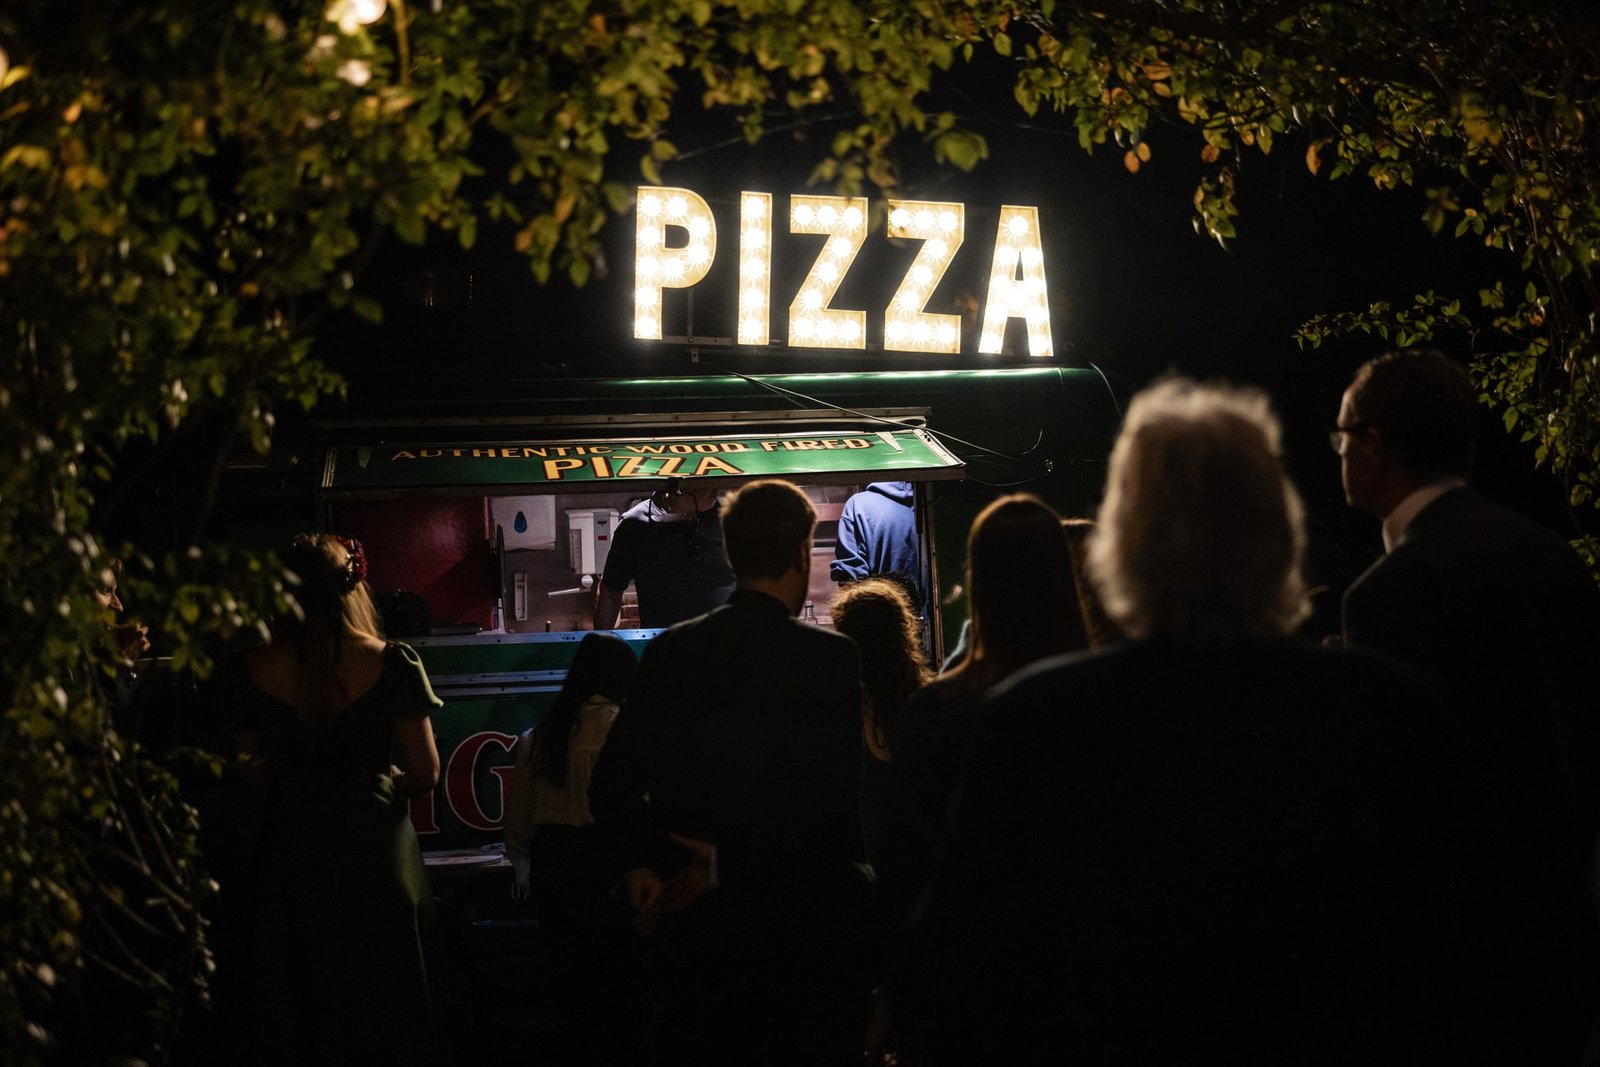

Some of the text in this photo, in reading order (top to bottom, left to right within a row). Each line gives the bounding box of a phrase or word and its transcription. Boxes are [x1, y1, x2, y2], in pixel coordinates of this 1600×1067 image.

[634, 186, 1053, 356] PIZZA
[391, 439, 873, 461] AUTHENTIC WOOD FIRED
[543, 457, 743, 480] PIZZA
